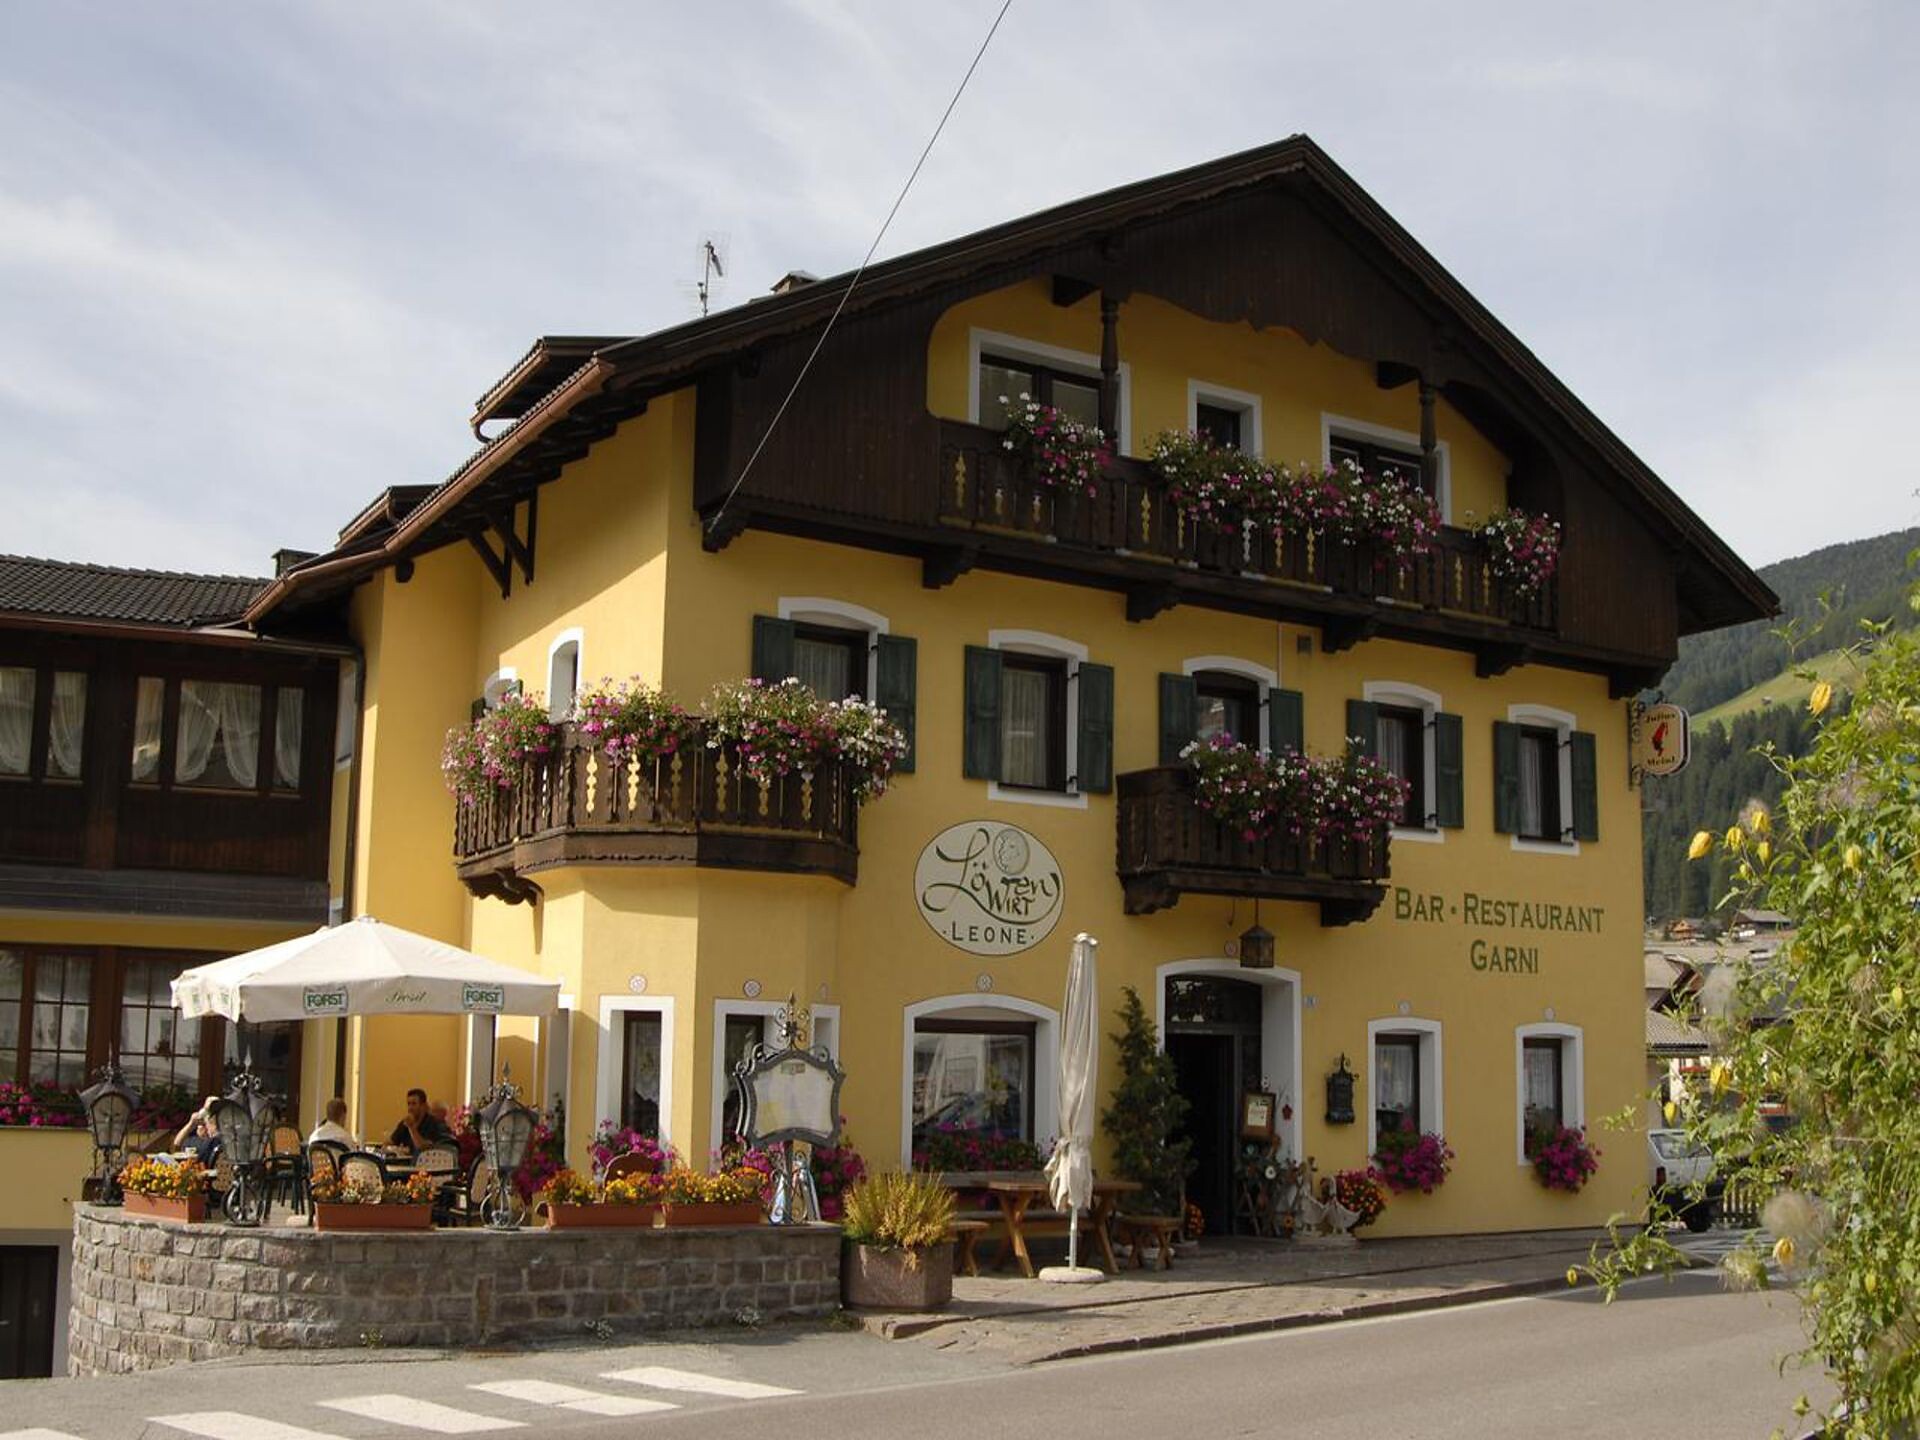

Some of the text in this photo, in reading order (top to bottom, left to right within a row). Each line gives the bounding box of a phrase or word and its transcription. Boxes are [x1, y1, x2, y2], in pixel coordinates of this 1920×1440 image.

[1395, 887, 1604, 933] BAR RESTAURANT
[952, 921, 1027, 944] LEONE
[1470, 939, 1539, 974] GARNI
[306, 992, 345, 1008] FORST
[465, 990, 500, 1003] FORST
